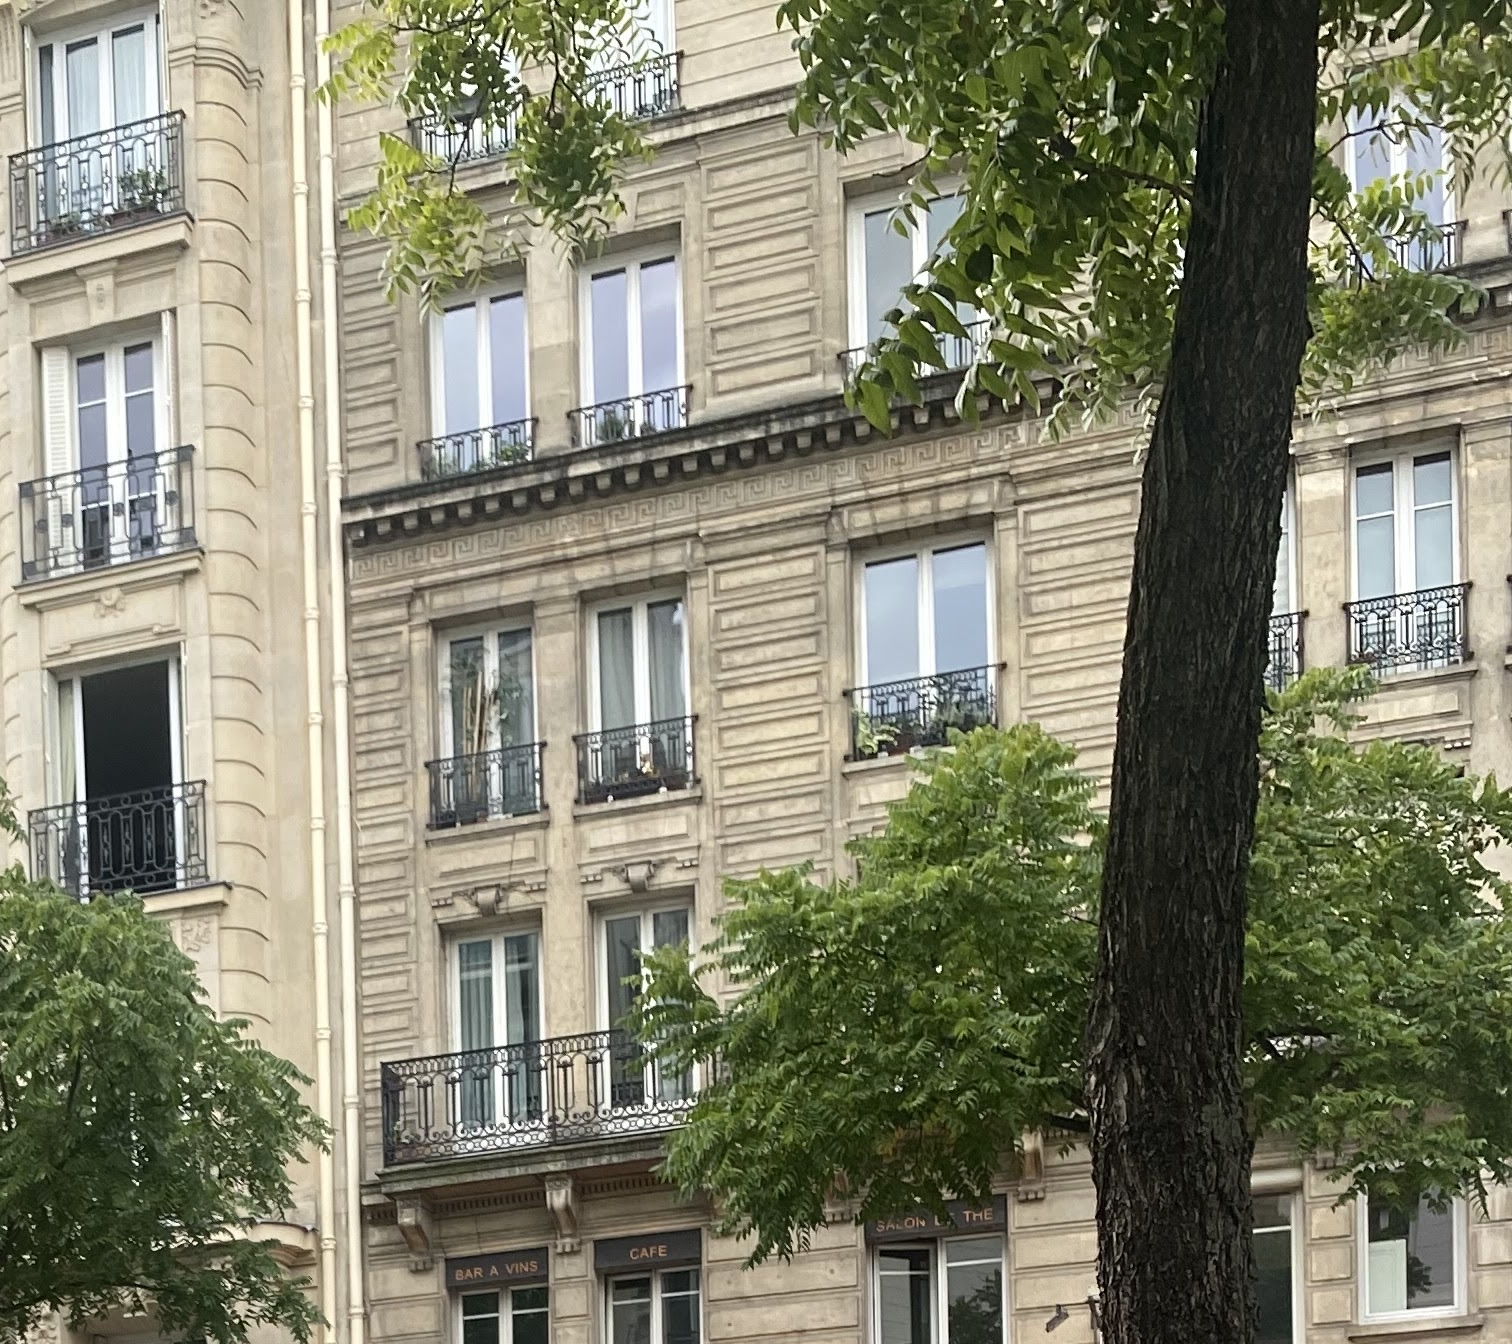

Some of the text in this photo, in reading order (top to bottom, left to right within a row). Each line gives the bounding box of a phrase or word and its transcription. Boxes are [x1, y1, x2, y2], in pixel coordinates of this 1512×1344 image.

[962, 1208, 994, 1222] THE
[629, 1244, 668, 1260] CAFE
[455, 1260, 538, 1281] BAR A VINS
